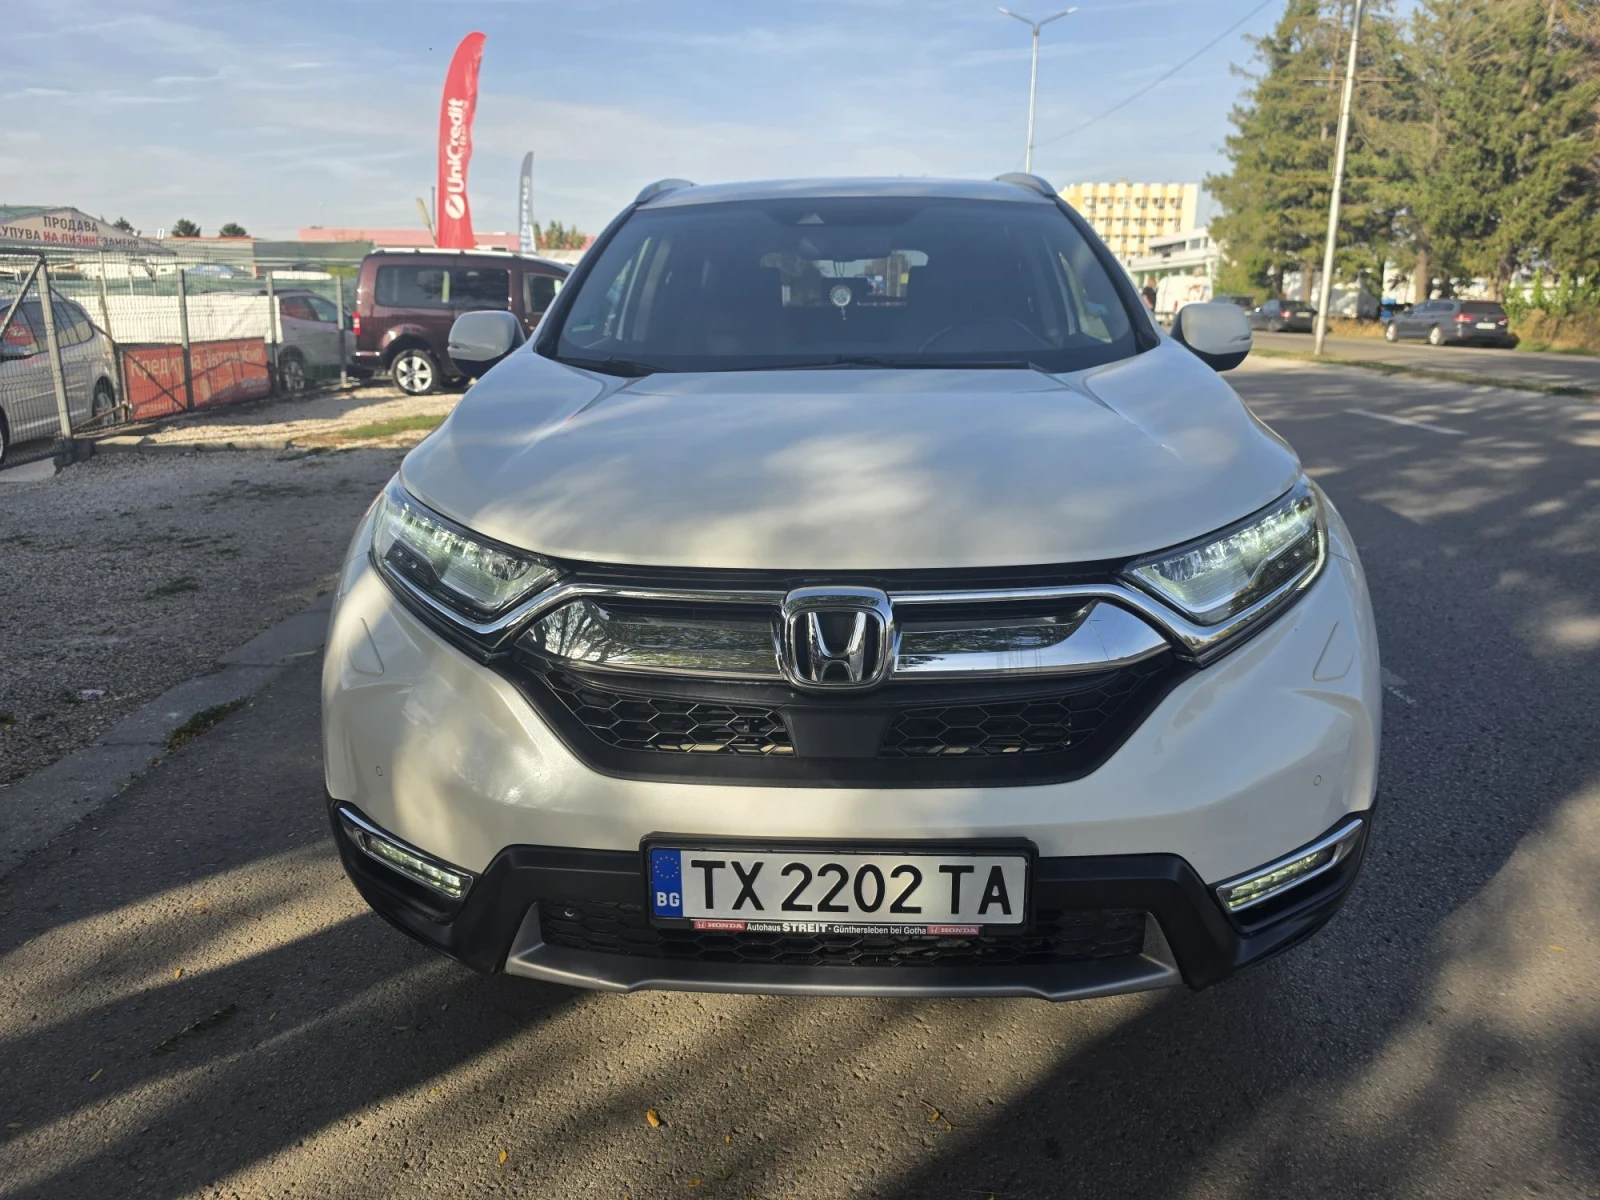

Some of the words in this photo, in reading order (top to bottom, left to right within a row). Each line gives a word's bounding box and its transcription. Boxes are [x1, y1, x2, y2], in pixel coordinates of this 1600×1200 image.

[447, 98, 465, 193] UniCredit
[43, 216, 98, 232] ПРОДАВА
[0, 226, 41, 240] УПУВА
[43, 231, 58, 243] НА
[60, 232, 100, 246] ЛИЗИНГ
[691, 860, 764, 911] TX
[780, 862, 922, 914] 2202
[939, 865, 1012, 915] TA
[656, 892, 680, 907] BG
[747, 923, 780, 931] Autohaus
[833, 925, 888, 935] Günthersleben
[890, 925, 901, 934] bei
[904, 926, 926, 935] Gotha
